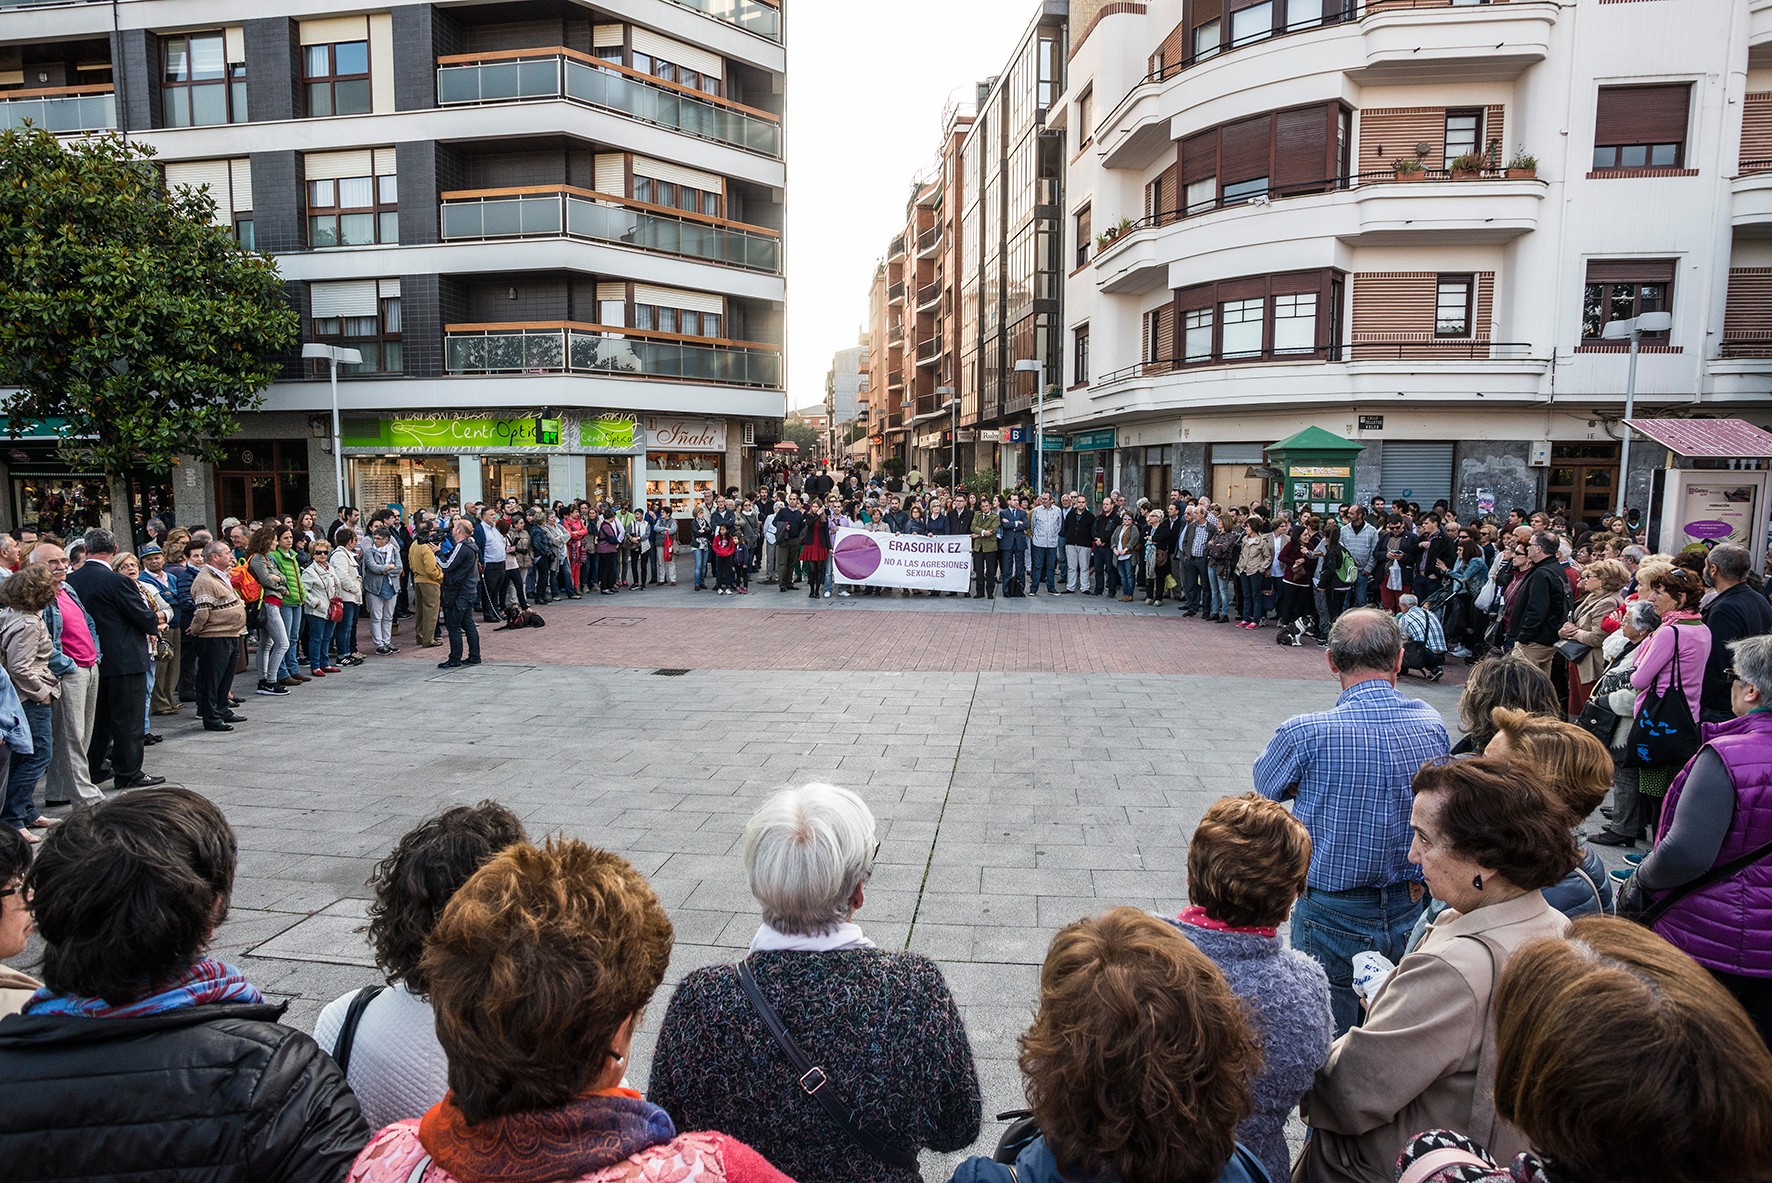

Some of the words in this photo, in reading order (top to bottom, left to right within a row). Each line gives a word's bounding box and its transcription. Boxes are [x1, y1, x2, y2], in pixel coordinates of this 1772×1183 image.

[452, 419, 537, 447] CentrÓptic
[656, 421, 716, 446] Iñaki
[983, 431, 999, 440] Ruby
[1012, 430, 1020, 440] B
[889, 540, 945, 553] ERASORIK
[948, 543, 961, 553] EZ
[884, 557, 896, 566] NO
[896, 559, 903, 567] A
[904, 559, 920, 568] LAS
[920, 560, 969, 570] AGRESIONES
[906, 569, 945, 578] SEXUALES
